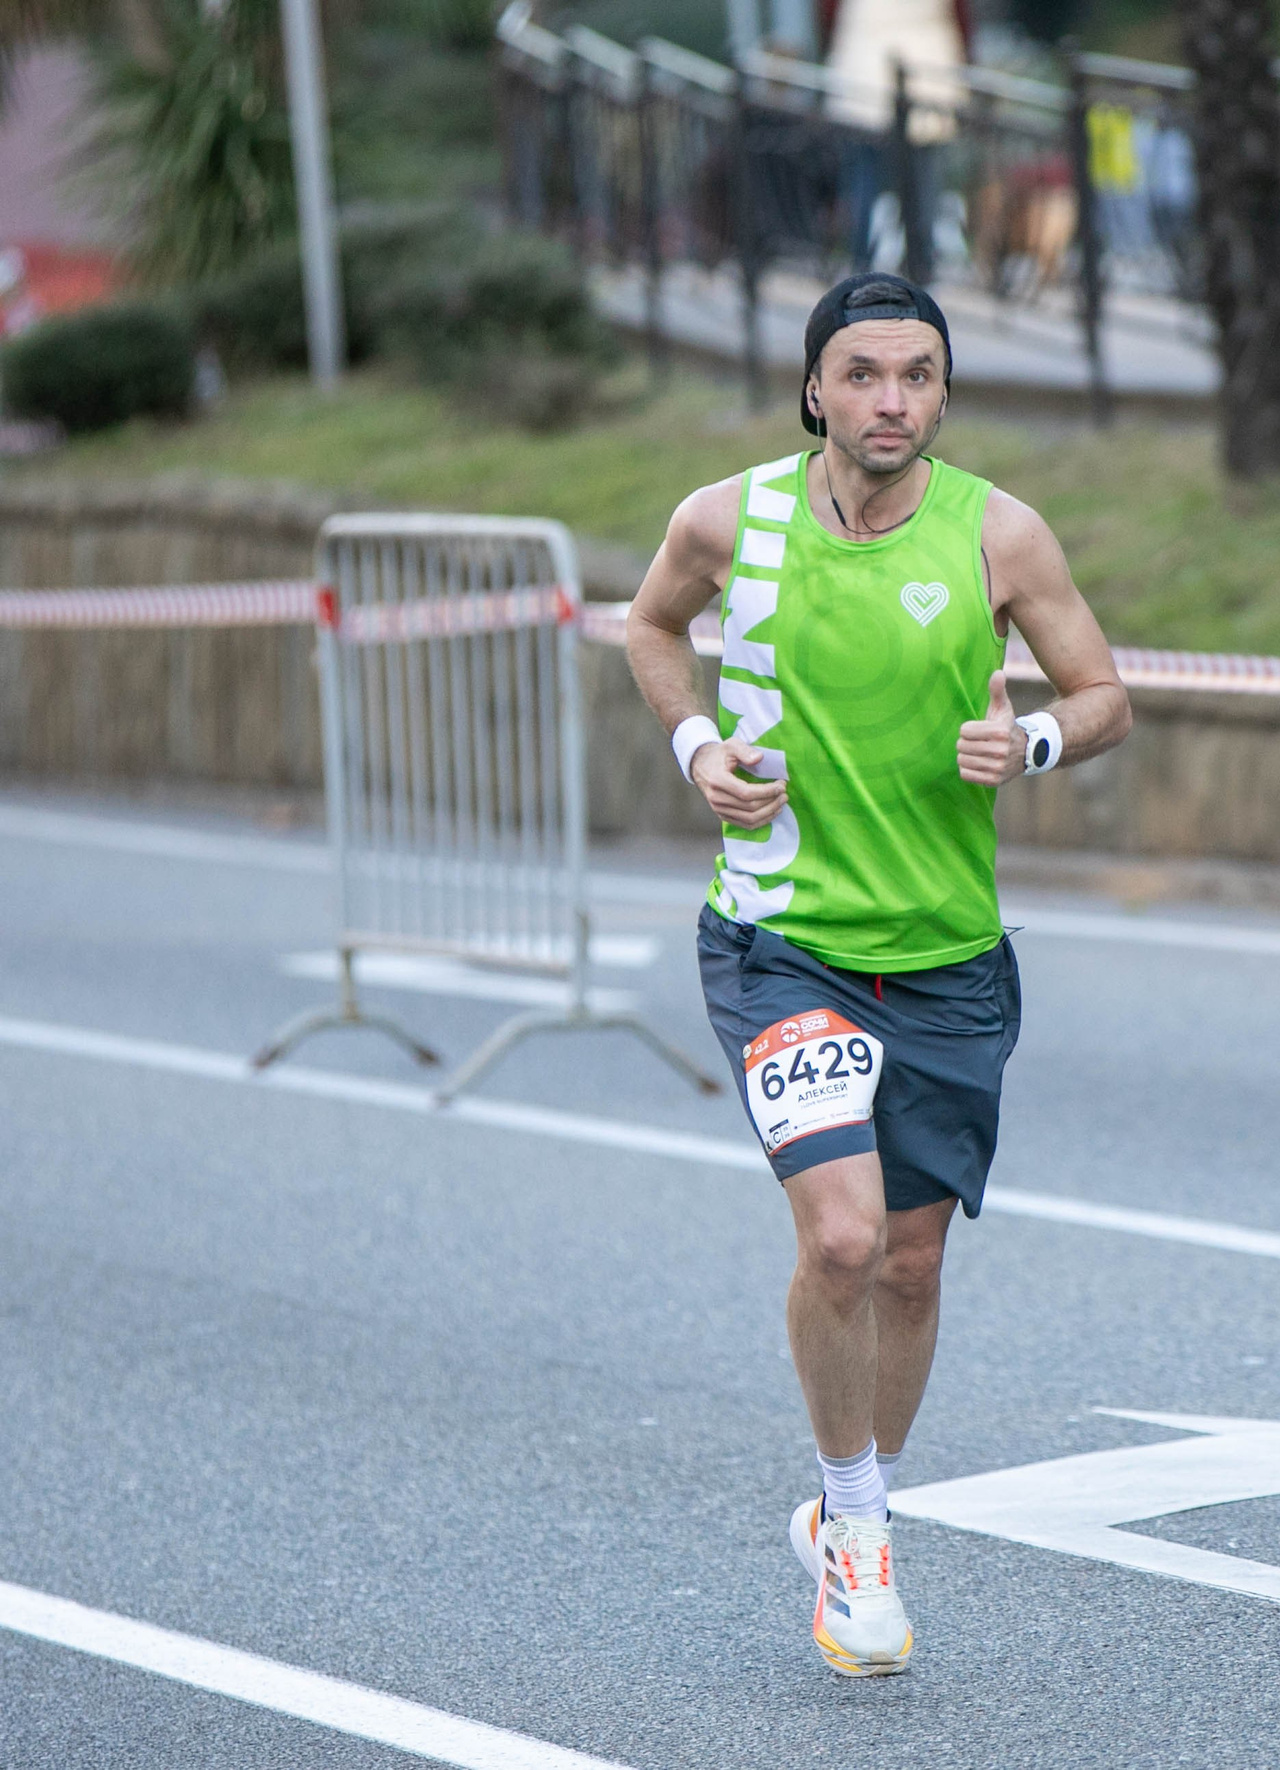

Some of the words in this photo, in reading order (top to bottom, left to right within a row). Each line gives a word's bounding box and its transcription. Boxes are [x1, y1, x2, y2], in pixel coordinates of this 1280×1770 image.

[800, 1016, 829, 1030] СОЧИ
[761, 1037, 873, 1101] 6429
[797, 1081, 848, 1103] АЛЕКСЕЙ
